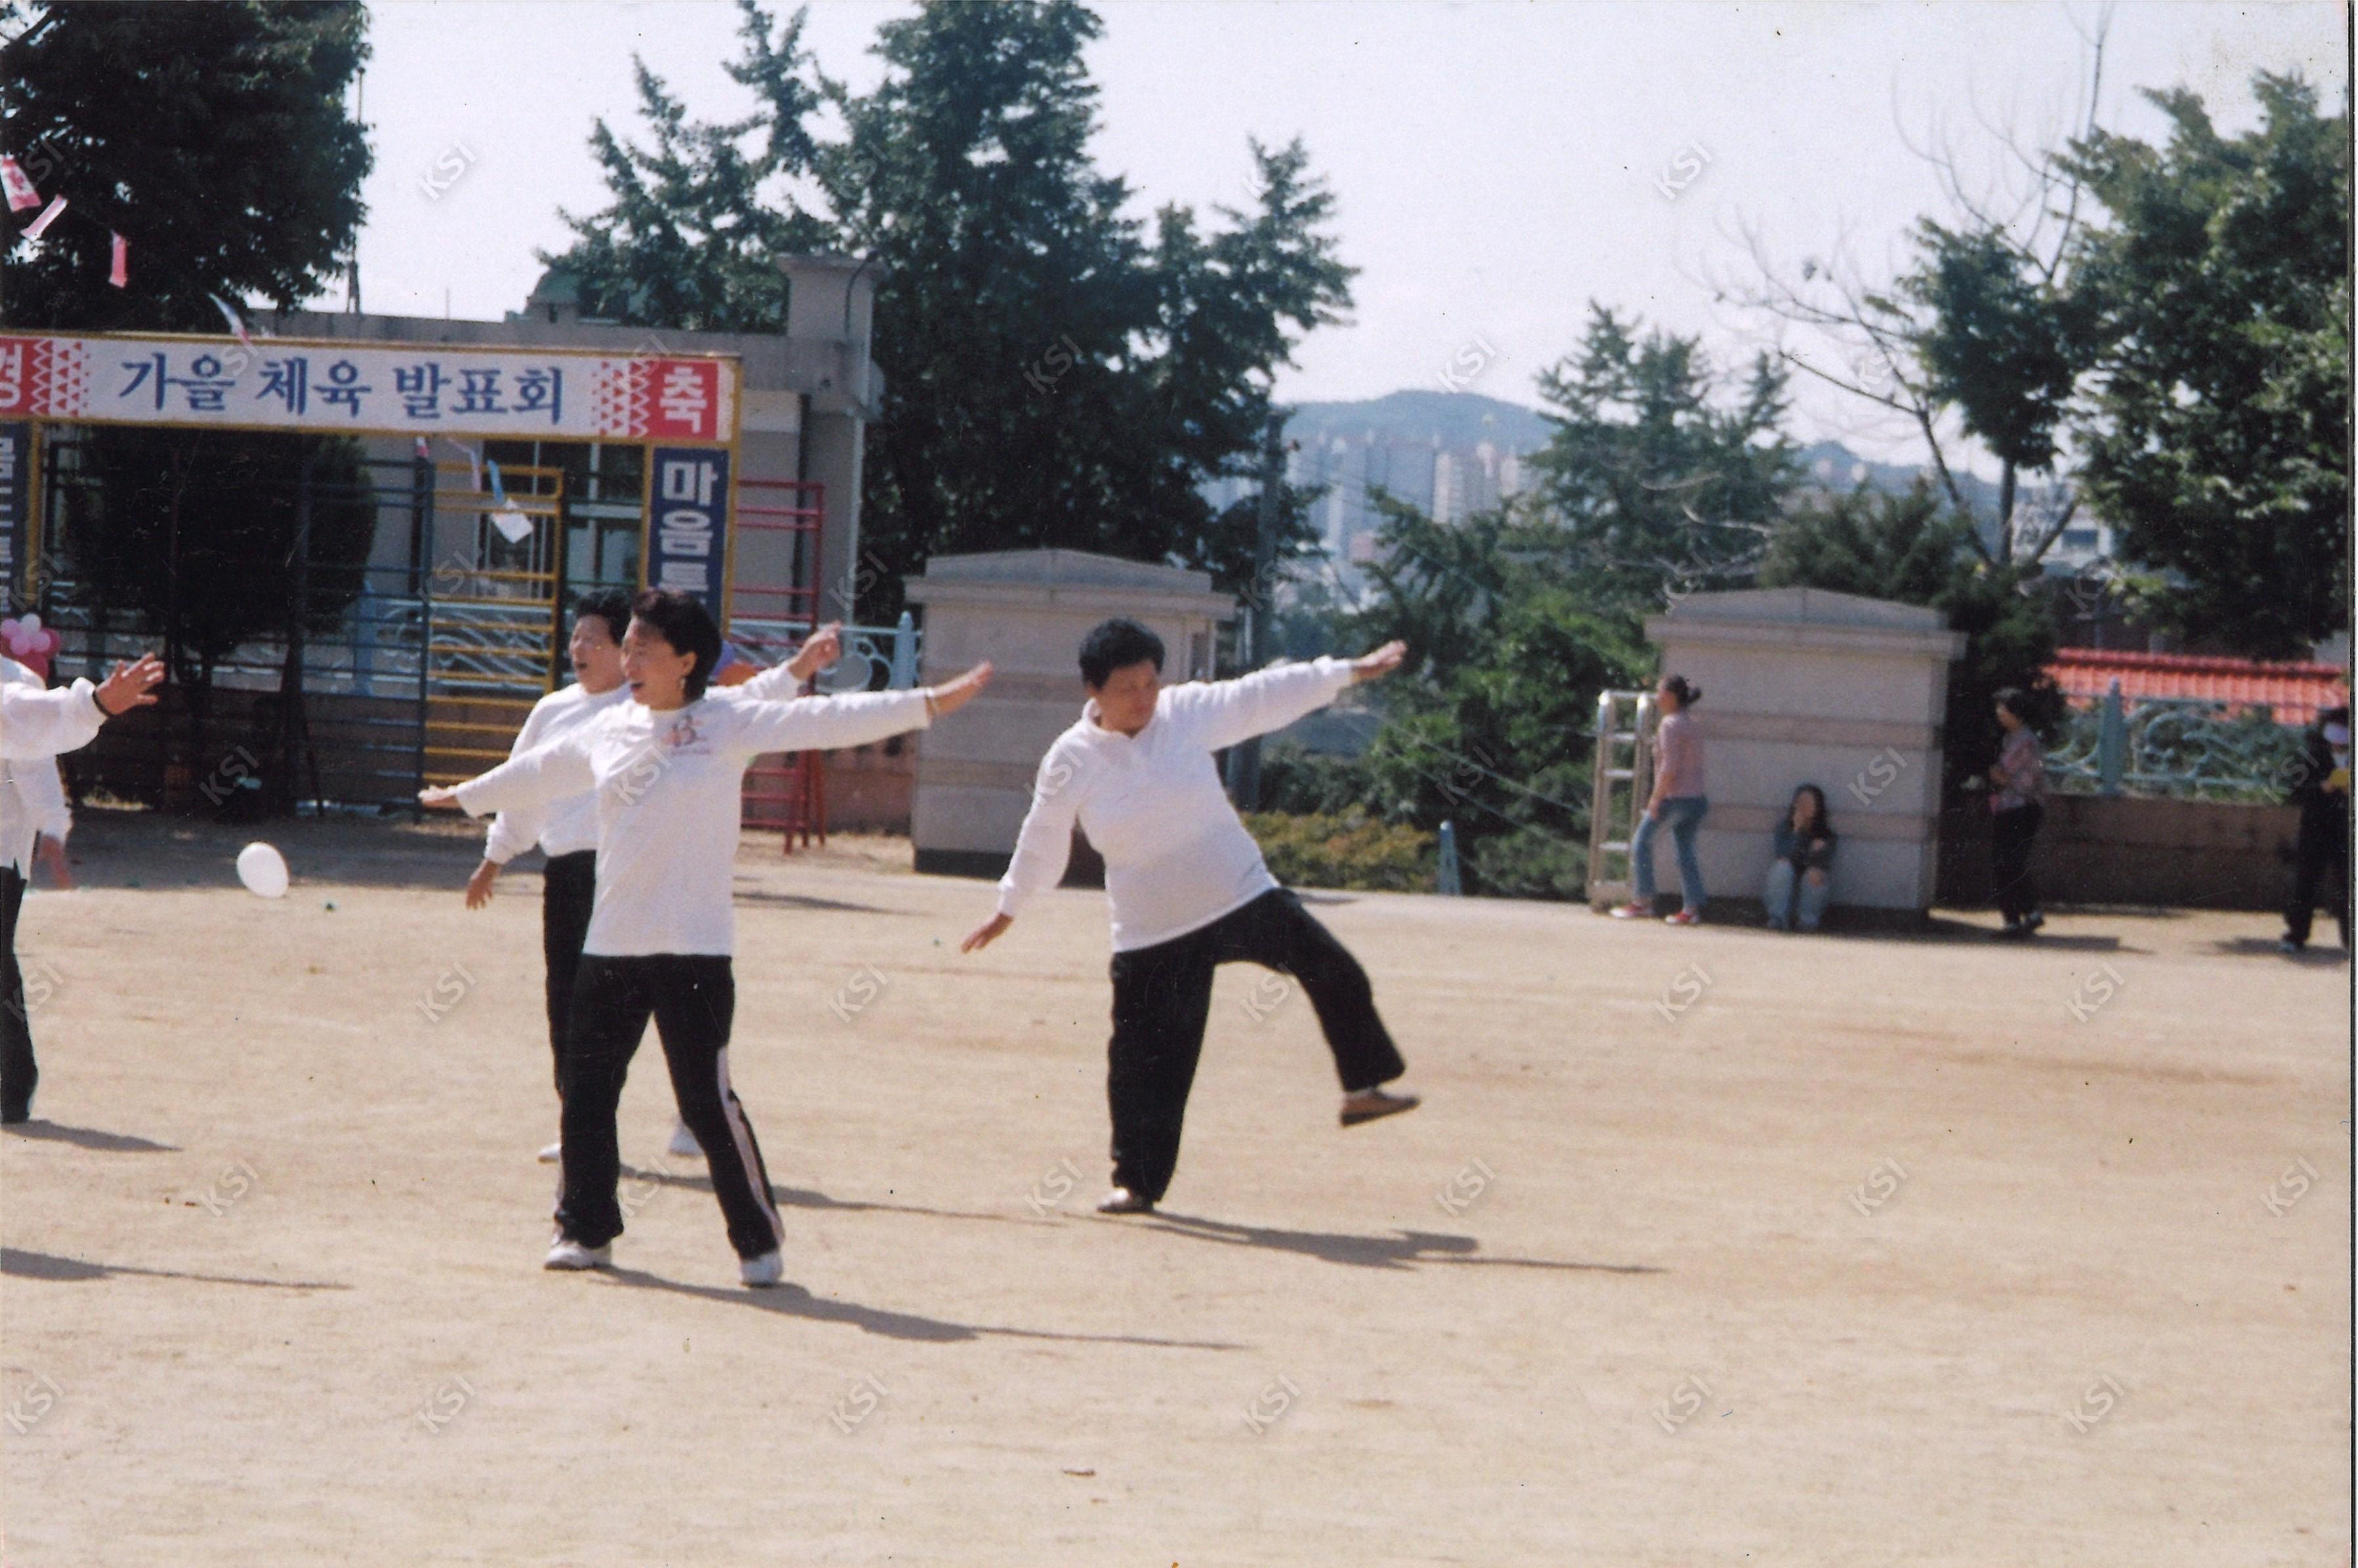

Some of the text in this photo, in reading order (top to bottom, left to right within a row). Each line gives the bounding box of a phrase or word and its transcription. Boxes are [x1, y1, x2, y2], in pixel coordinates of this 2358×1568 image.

[119, 351, 563, 426] 가을 체육 발표회
[659, 365, 707, 434] 축
